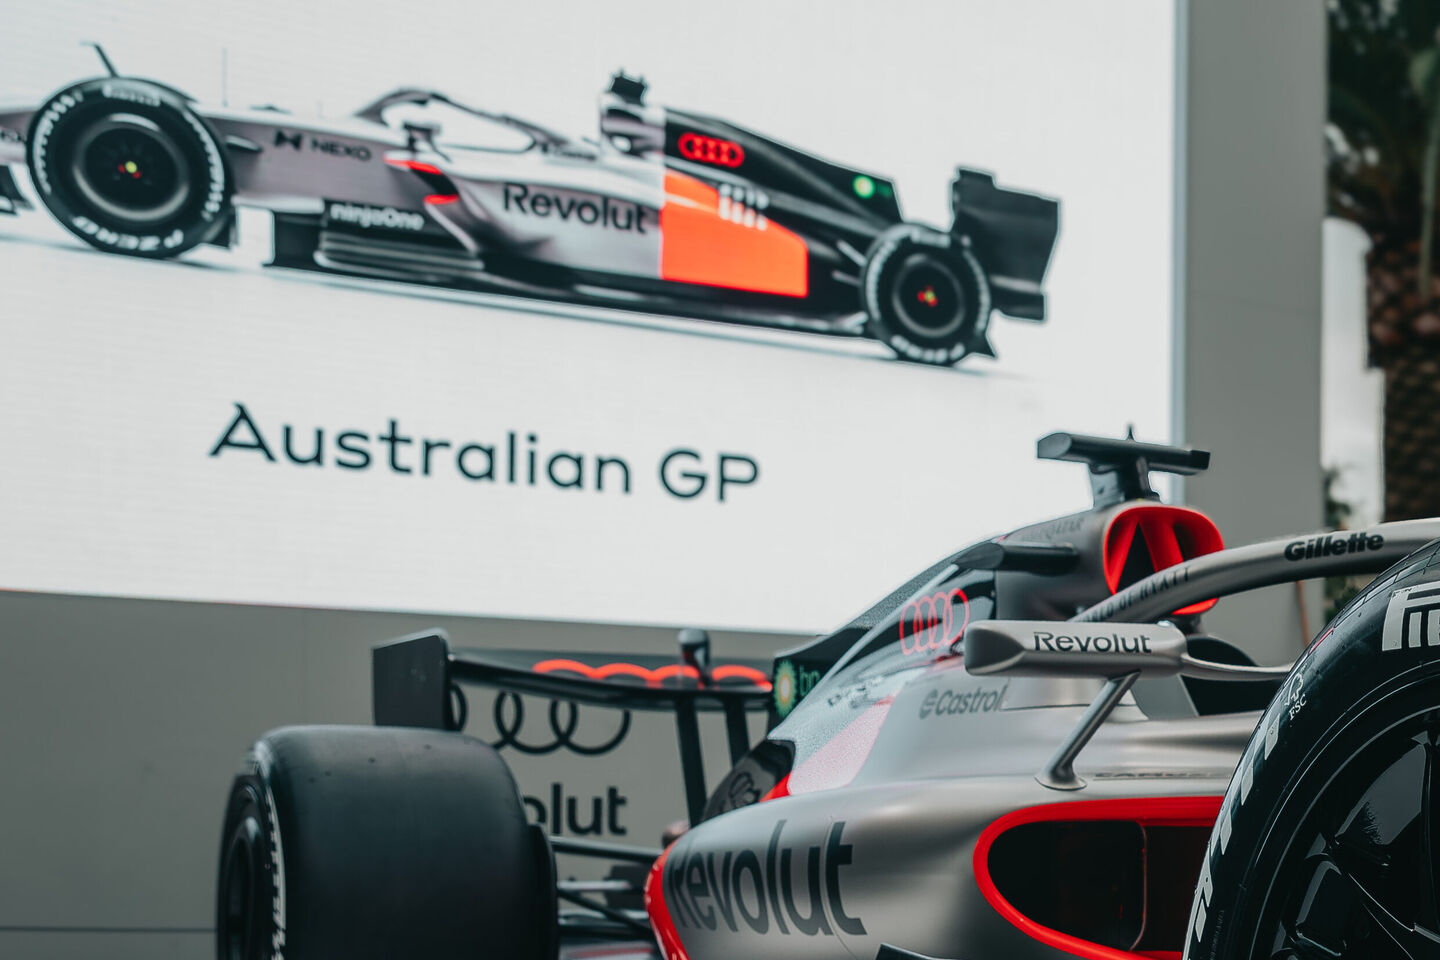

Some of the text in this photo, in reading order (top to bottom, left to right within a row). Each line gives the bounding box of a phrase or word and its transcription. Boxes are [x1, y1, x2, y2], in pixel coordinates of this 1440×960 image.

[311, 137, 373, 162] NEXO
[330, 202, 425, 231] ninjaOne
[503, 181, 647, 235] Revolut
[208, 402, 760, 503] Australian GP
[1284, 531, 1385, 562] Gillette
[1033, 631, 1152, 654] Revolut
[935, 683, 1009, 717] Castrol
[1289, 690, 1307, 721] FSC
[667, 818, 868, 937] Revolut
